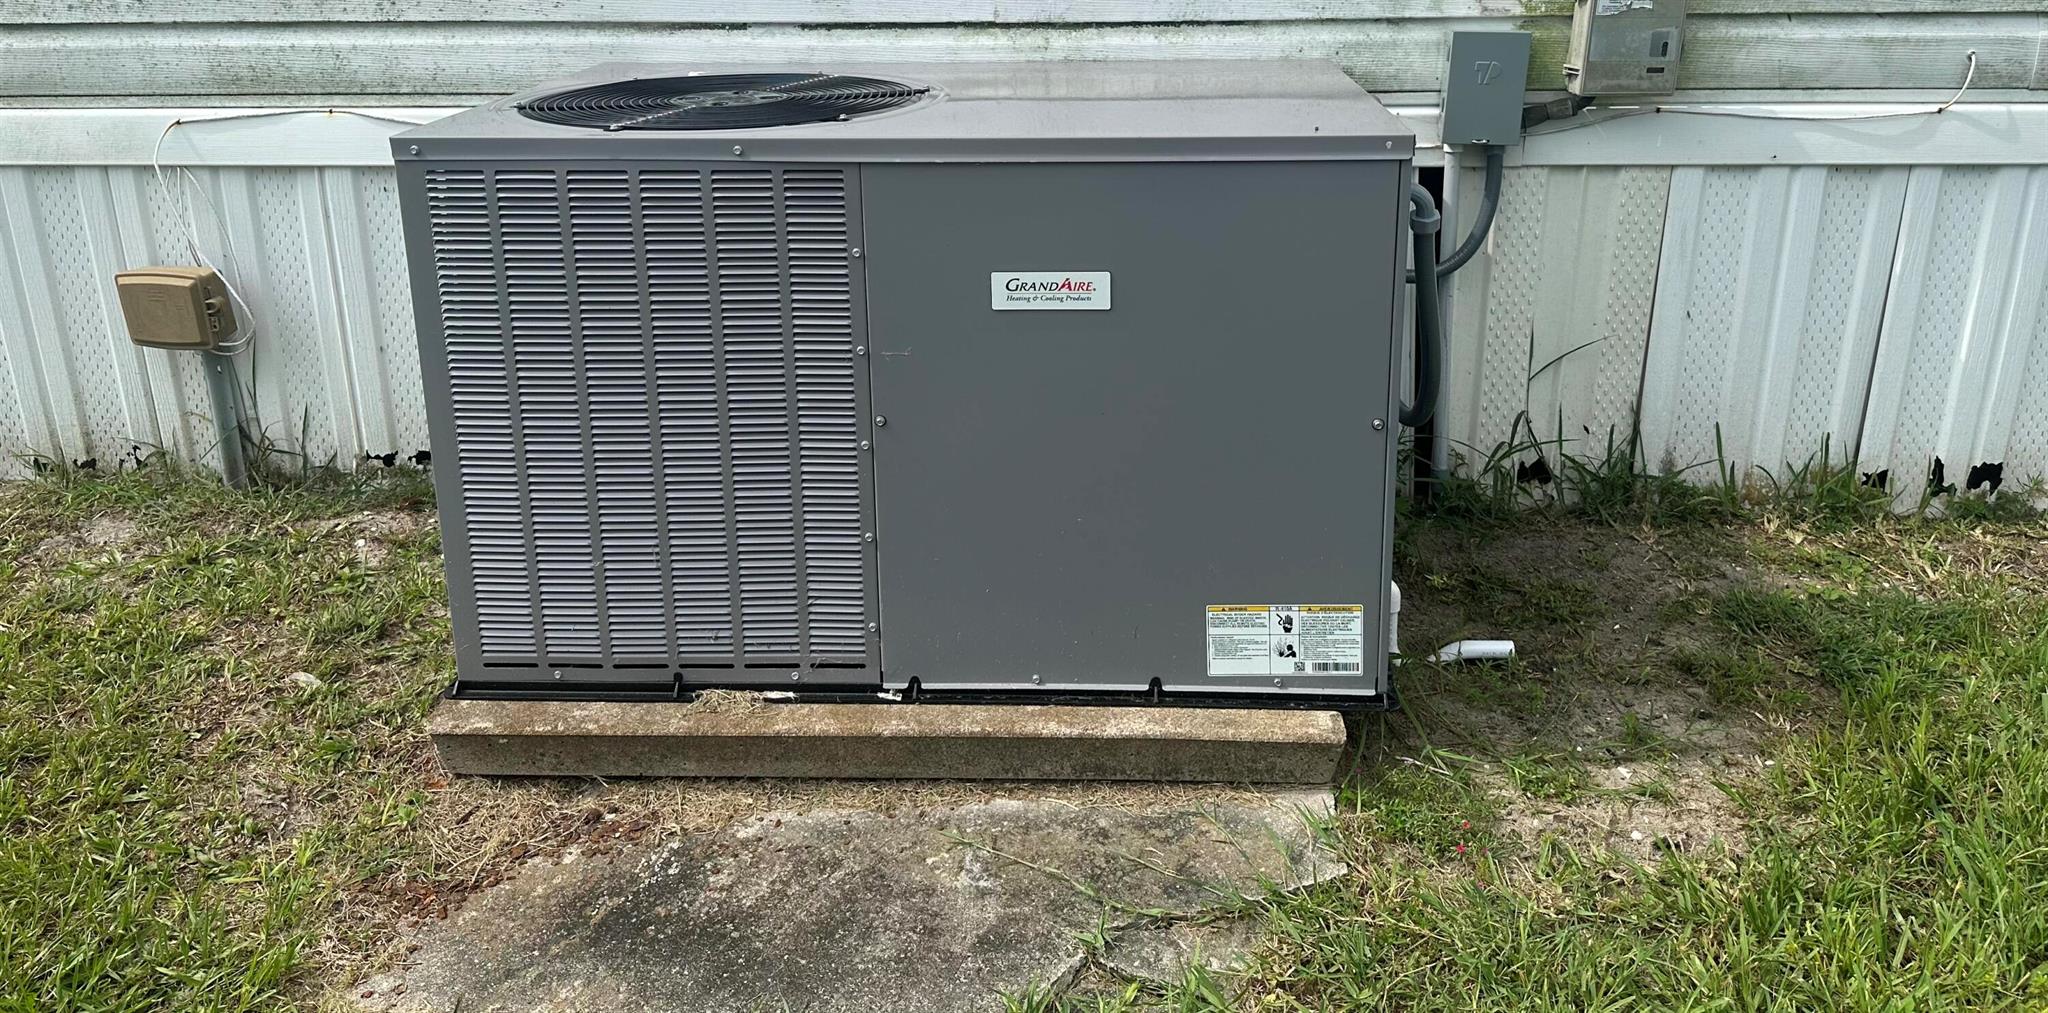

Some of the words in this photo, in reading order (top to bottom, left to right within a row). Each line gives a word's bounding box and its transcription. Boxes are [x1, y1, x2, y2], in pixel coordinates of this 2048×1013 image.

[1006, 295, 1031, 303] Heating
[1040, 295, 1064, 303] Cooling
[1065, 294, 1092, 302] Products
